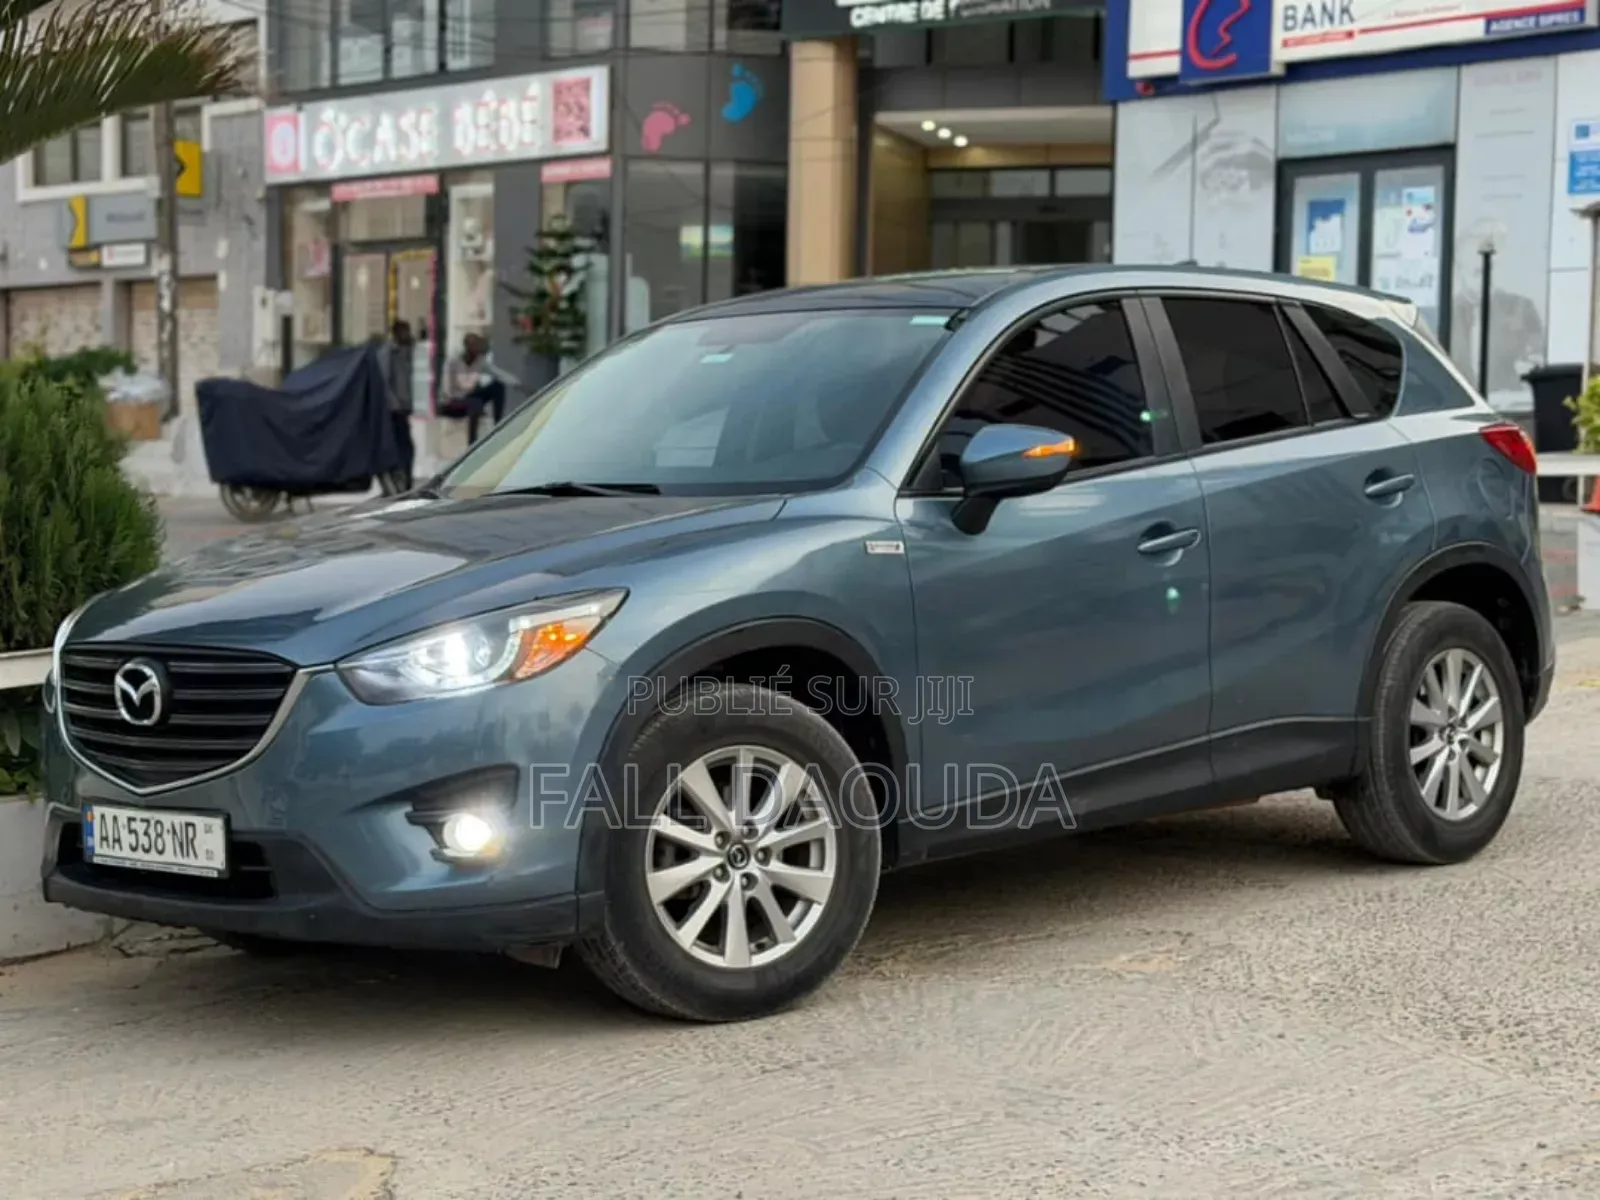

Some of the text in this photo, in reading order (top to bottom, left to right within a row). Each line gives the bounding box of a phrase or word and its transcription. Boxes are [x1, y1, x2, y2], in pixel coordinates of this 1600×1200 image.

[850, 2, 918, 28] CENTRE
[920, 0, 944, 20] DE
[1282, 0, 1355, 32] BANK
[1490, 15, 1536, 32] AGENCE
